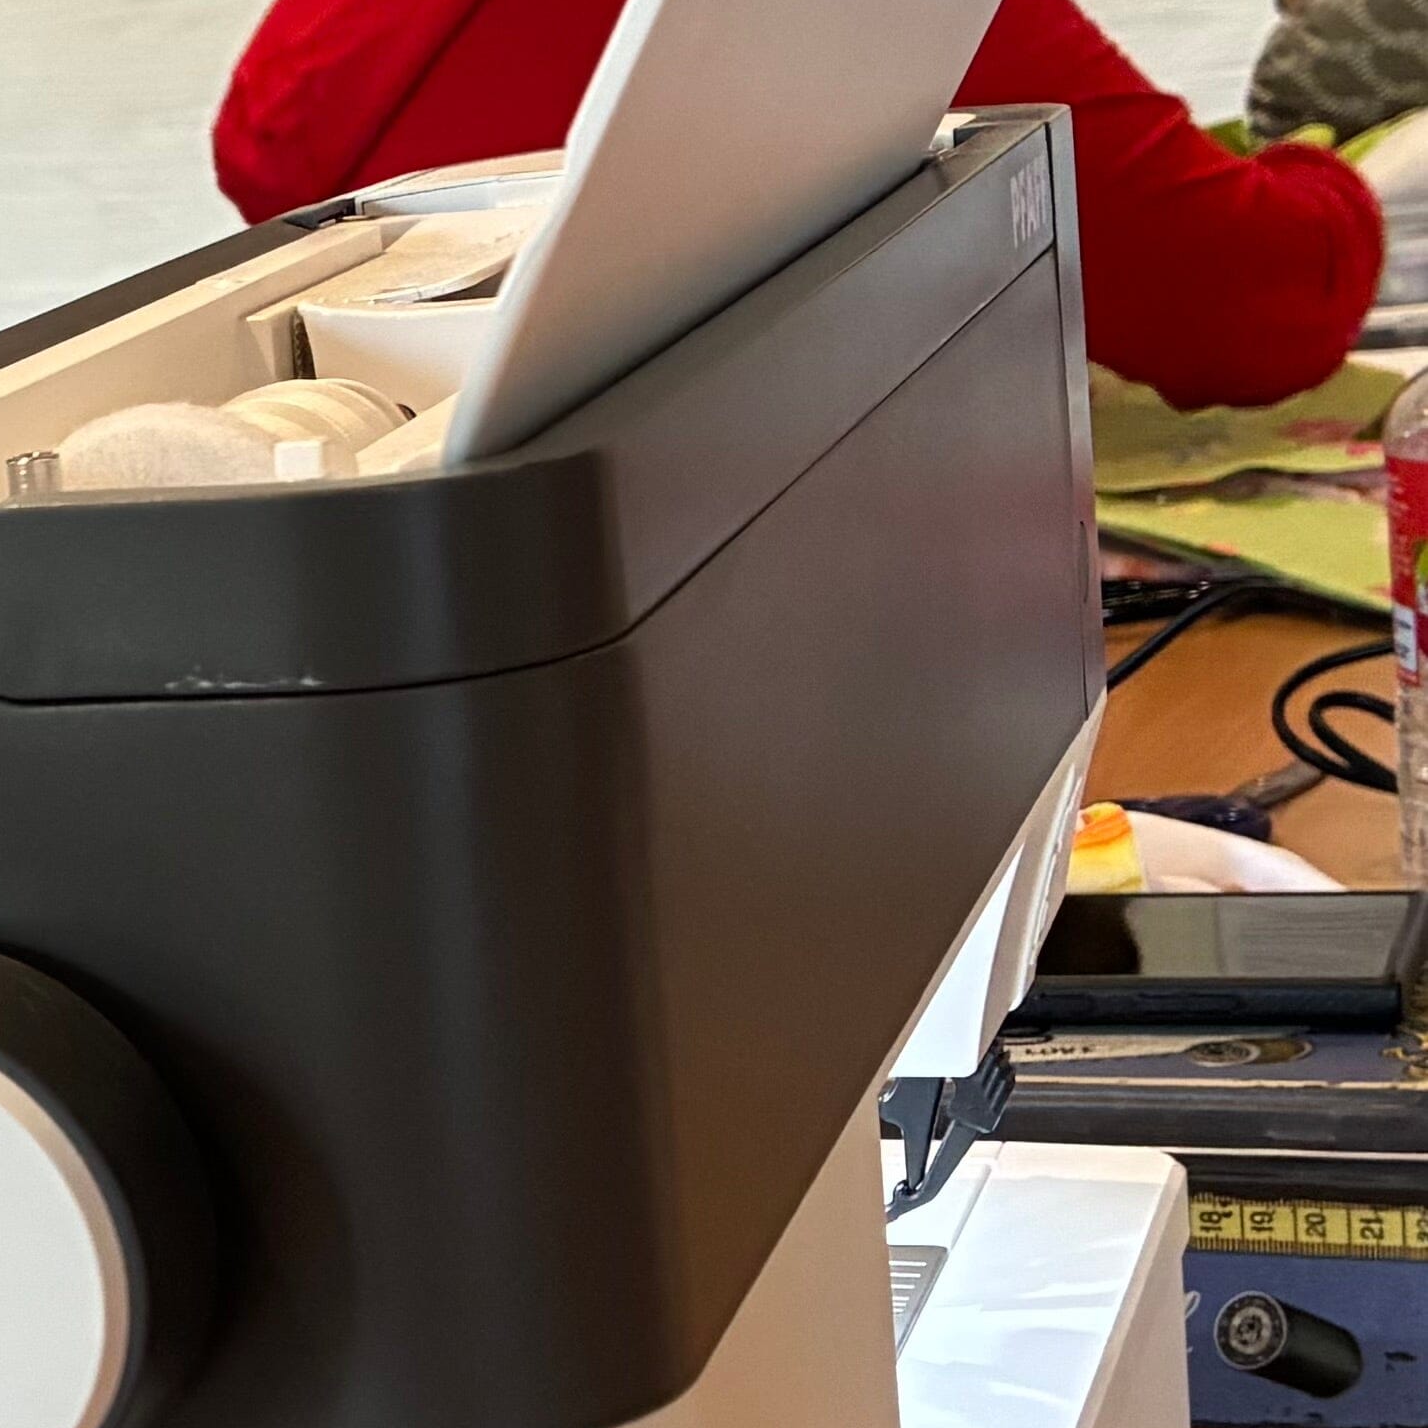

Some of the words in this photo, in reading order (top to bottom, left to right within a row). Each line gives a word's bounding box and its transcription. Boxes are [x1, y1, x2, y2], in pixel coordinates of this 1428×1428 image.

[1199, 1210, 1223, 1233] 18
[1250, 1210, 1274, 1232] 19
[1304, 1212, 1327, 1239] 20
[1359, 1217, 1384, 1240] 21
